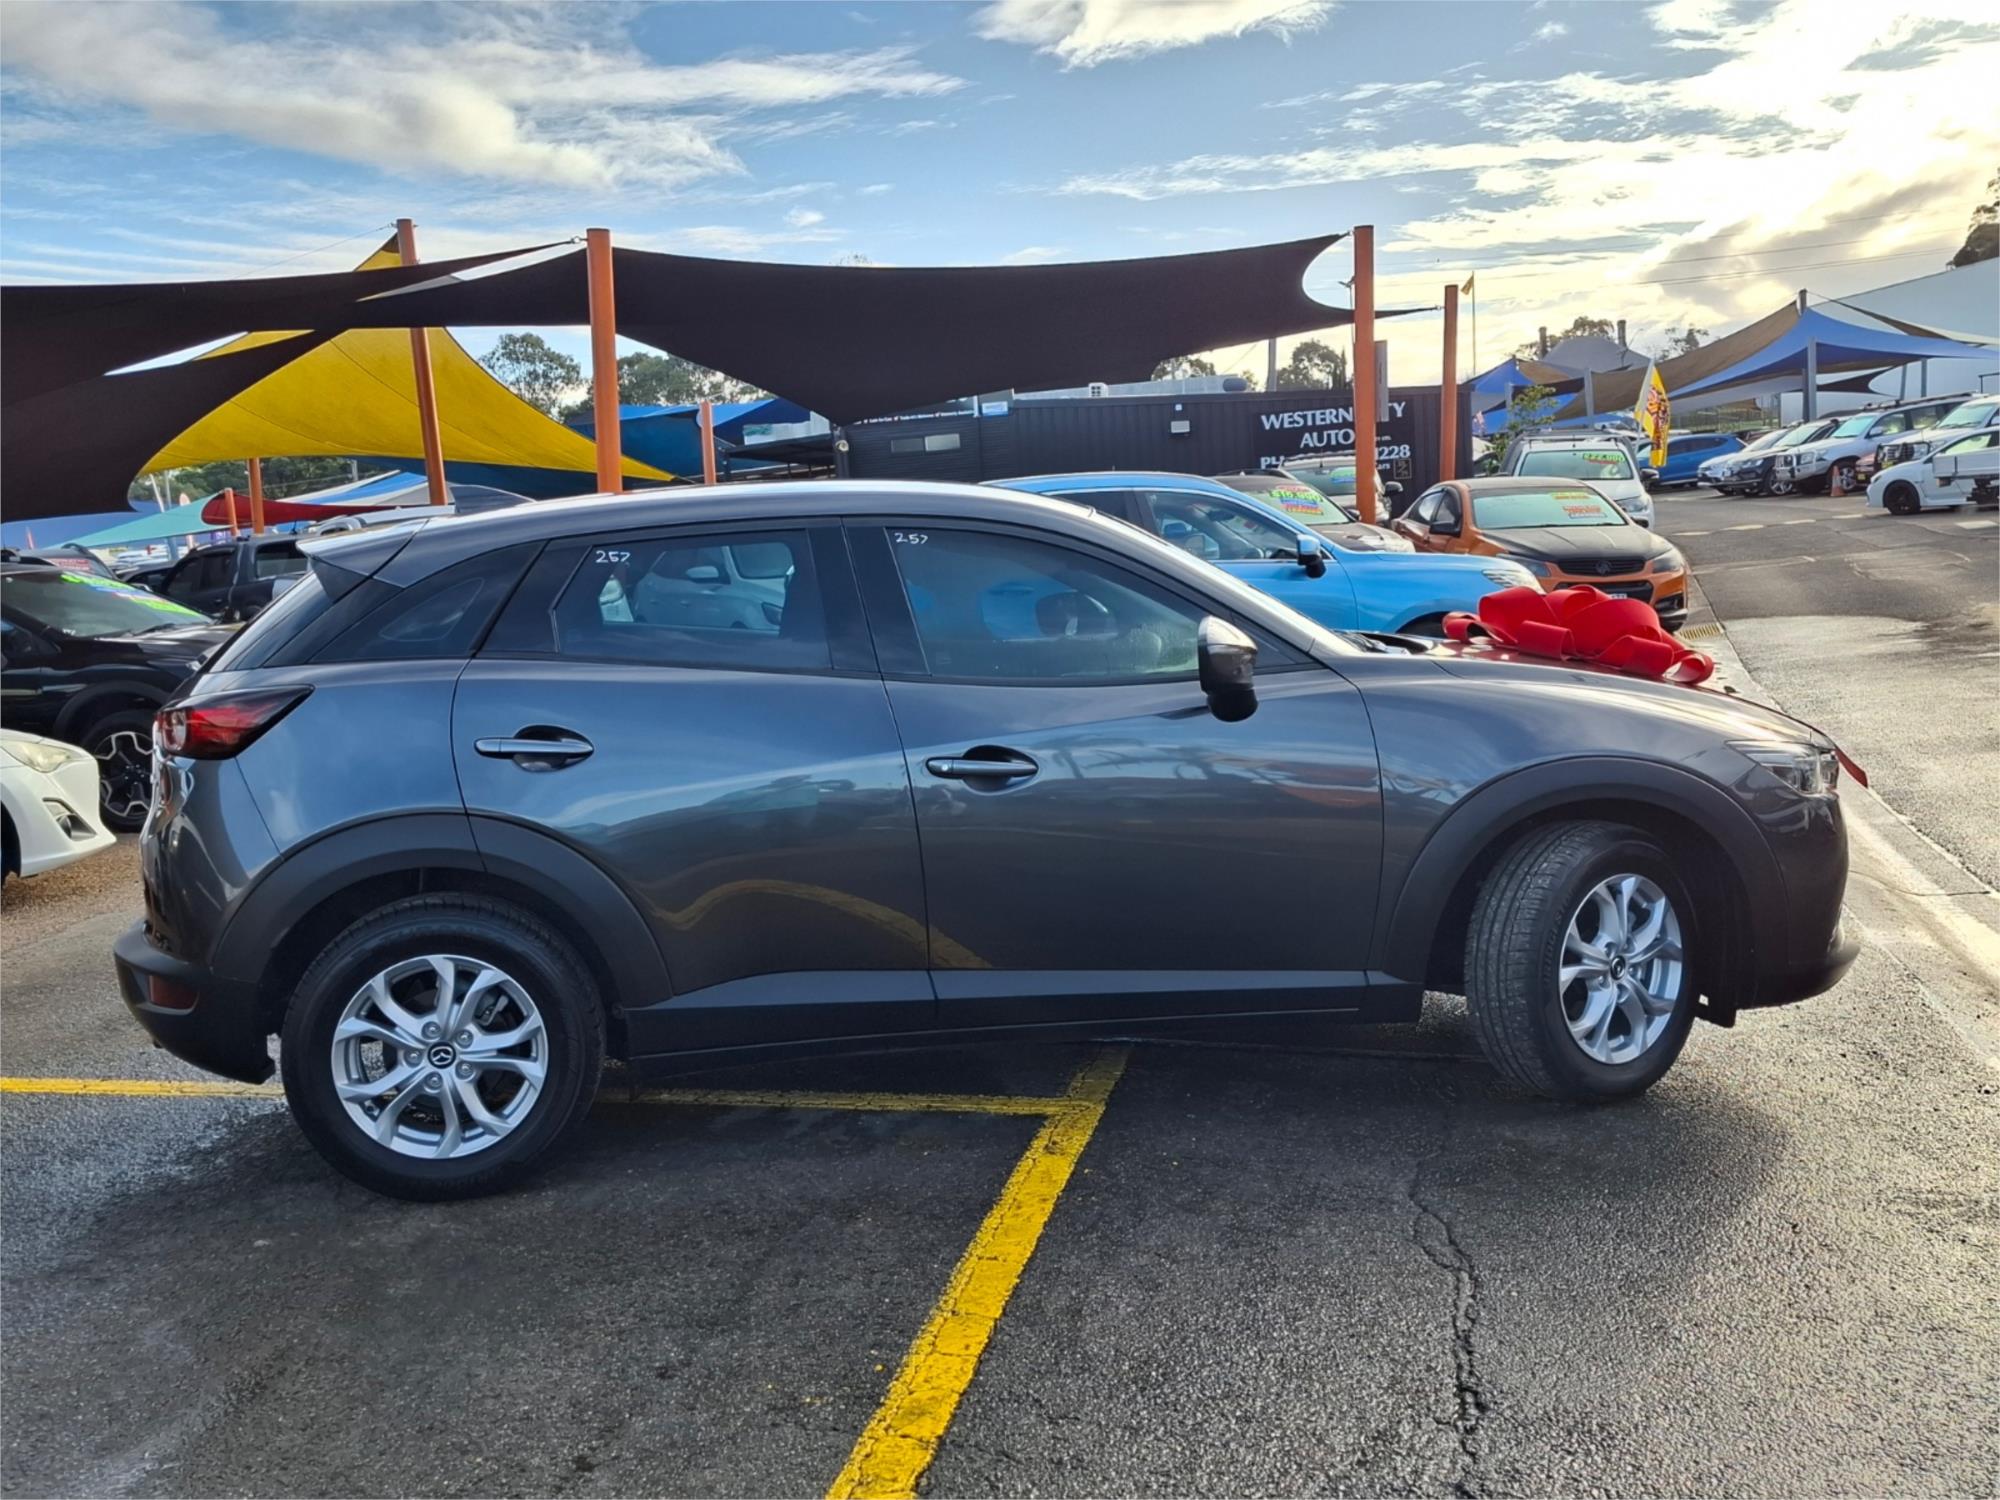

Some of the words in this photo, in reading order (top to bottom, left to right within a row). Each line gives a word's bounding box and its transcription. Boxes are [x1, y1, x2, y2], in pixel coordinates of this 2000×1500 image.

[1261, 406, 1353, 431] WESTERN
[1300, 428, 1355, 449] AUTO
[894, 532, 929, 545] 257
